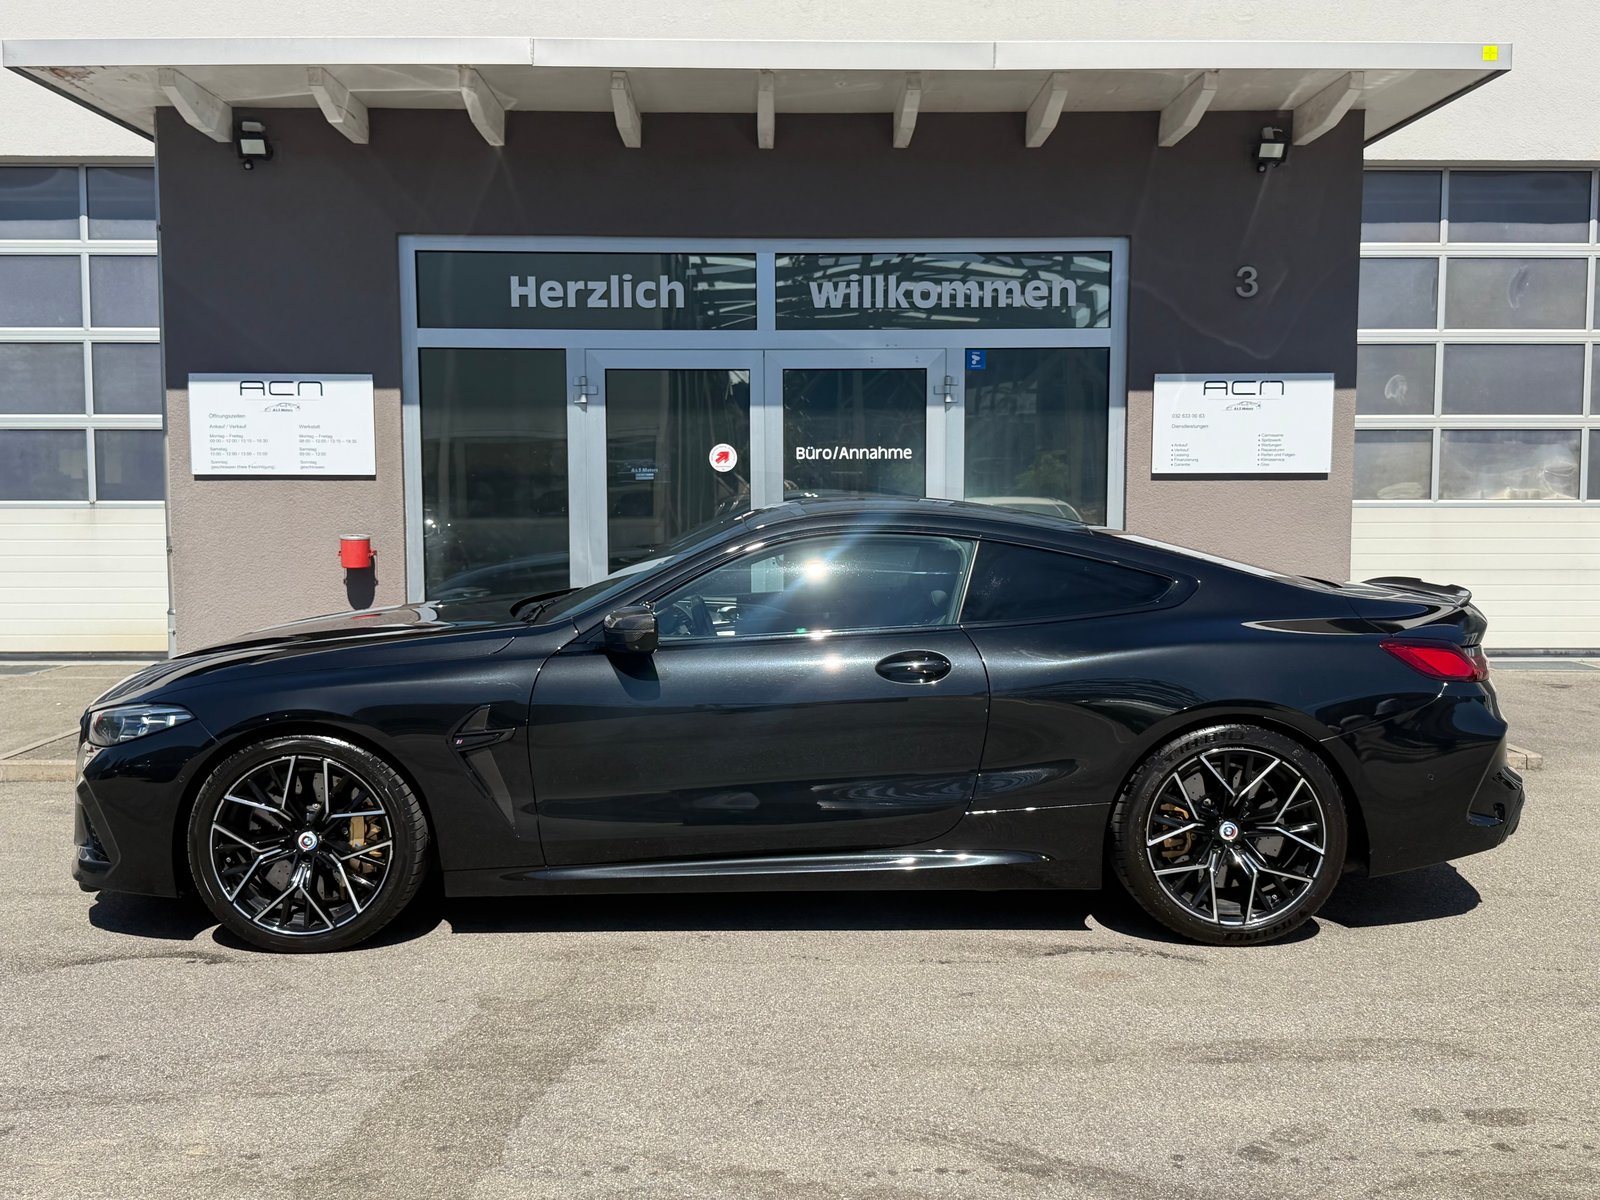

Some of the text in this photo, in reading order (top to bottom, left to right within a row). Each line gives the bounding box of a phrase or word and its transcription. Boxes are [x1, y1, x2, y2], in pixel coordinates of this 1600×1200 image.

[510, 274, 1076, 308] Herzlich willkommen
[1236, 266, 1258, 297] 3
[795, 446, 912, 460] Büro/Annahme
